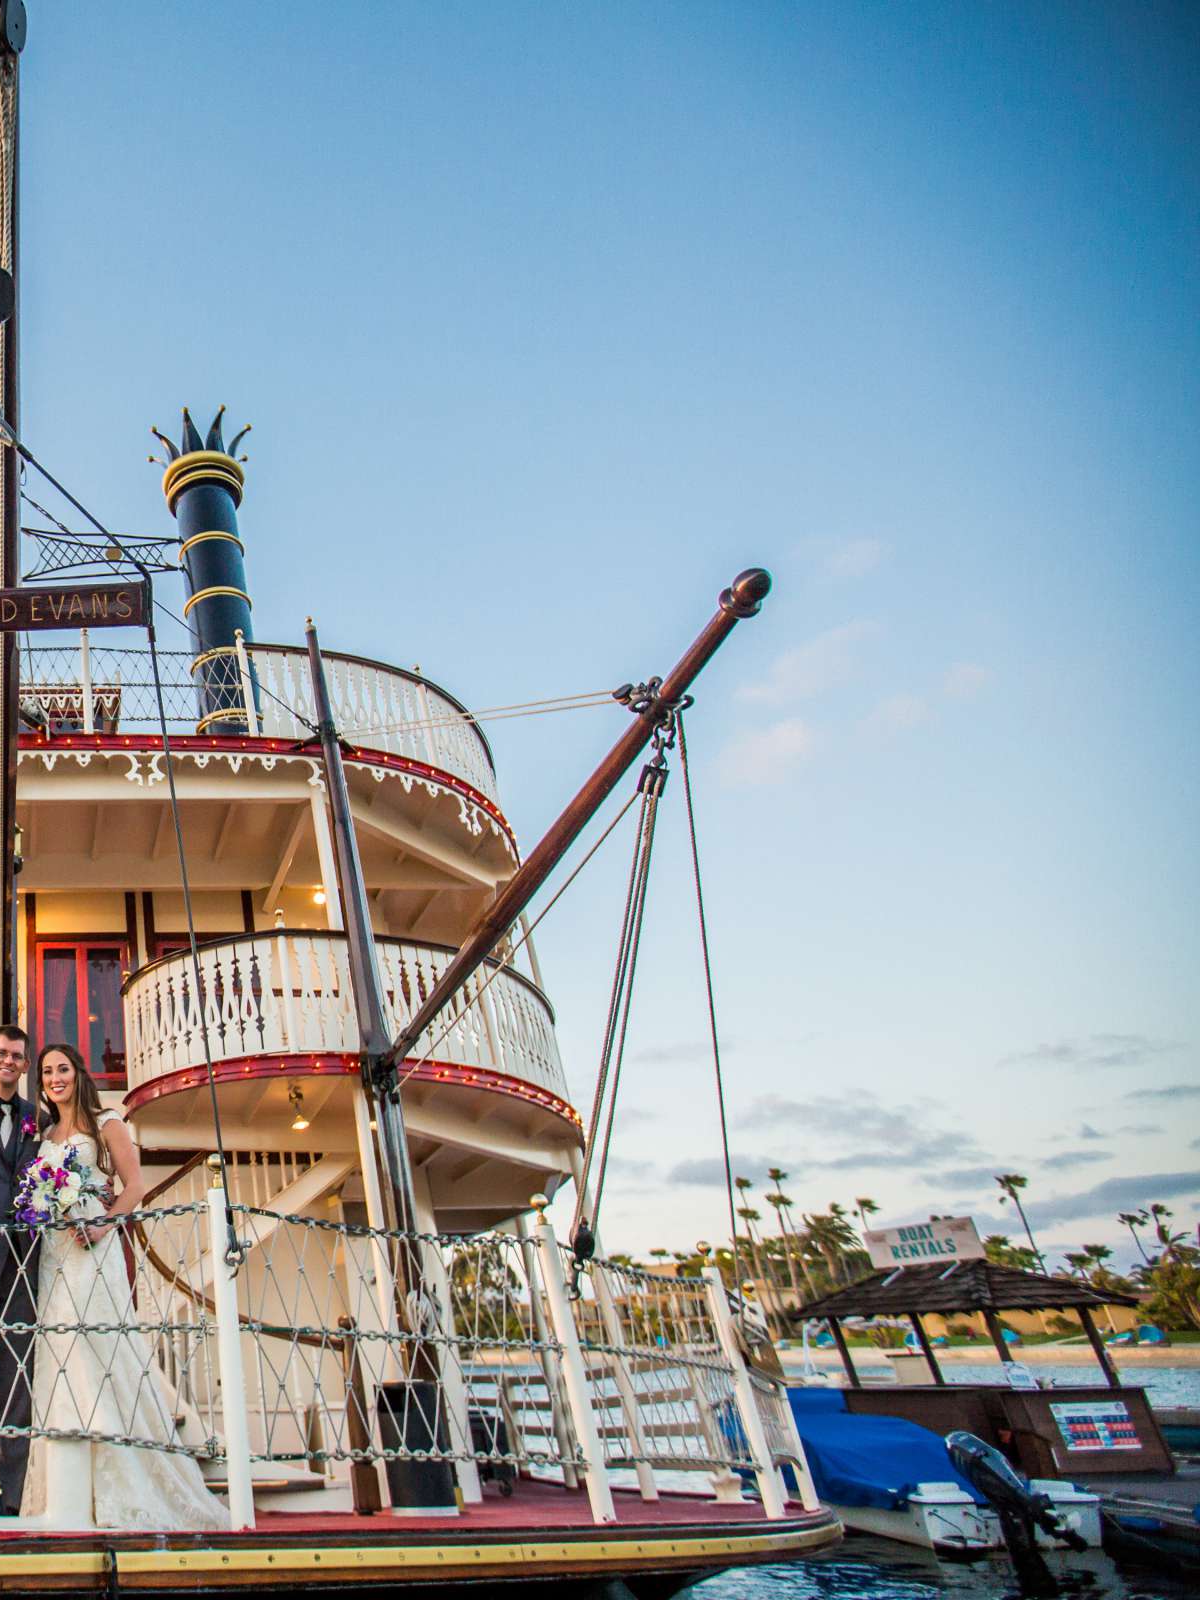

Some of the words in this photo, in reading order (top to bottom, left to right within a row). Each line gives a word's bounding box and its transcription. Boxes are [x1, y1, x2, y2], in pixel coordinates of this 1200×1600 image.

[30, 591, 133, 622] EVANS
[896, 1223, 934, 1242] BOAT
[890, 1238, 957, 1260] RENTALS
